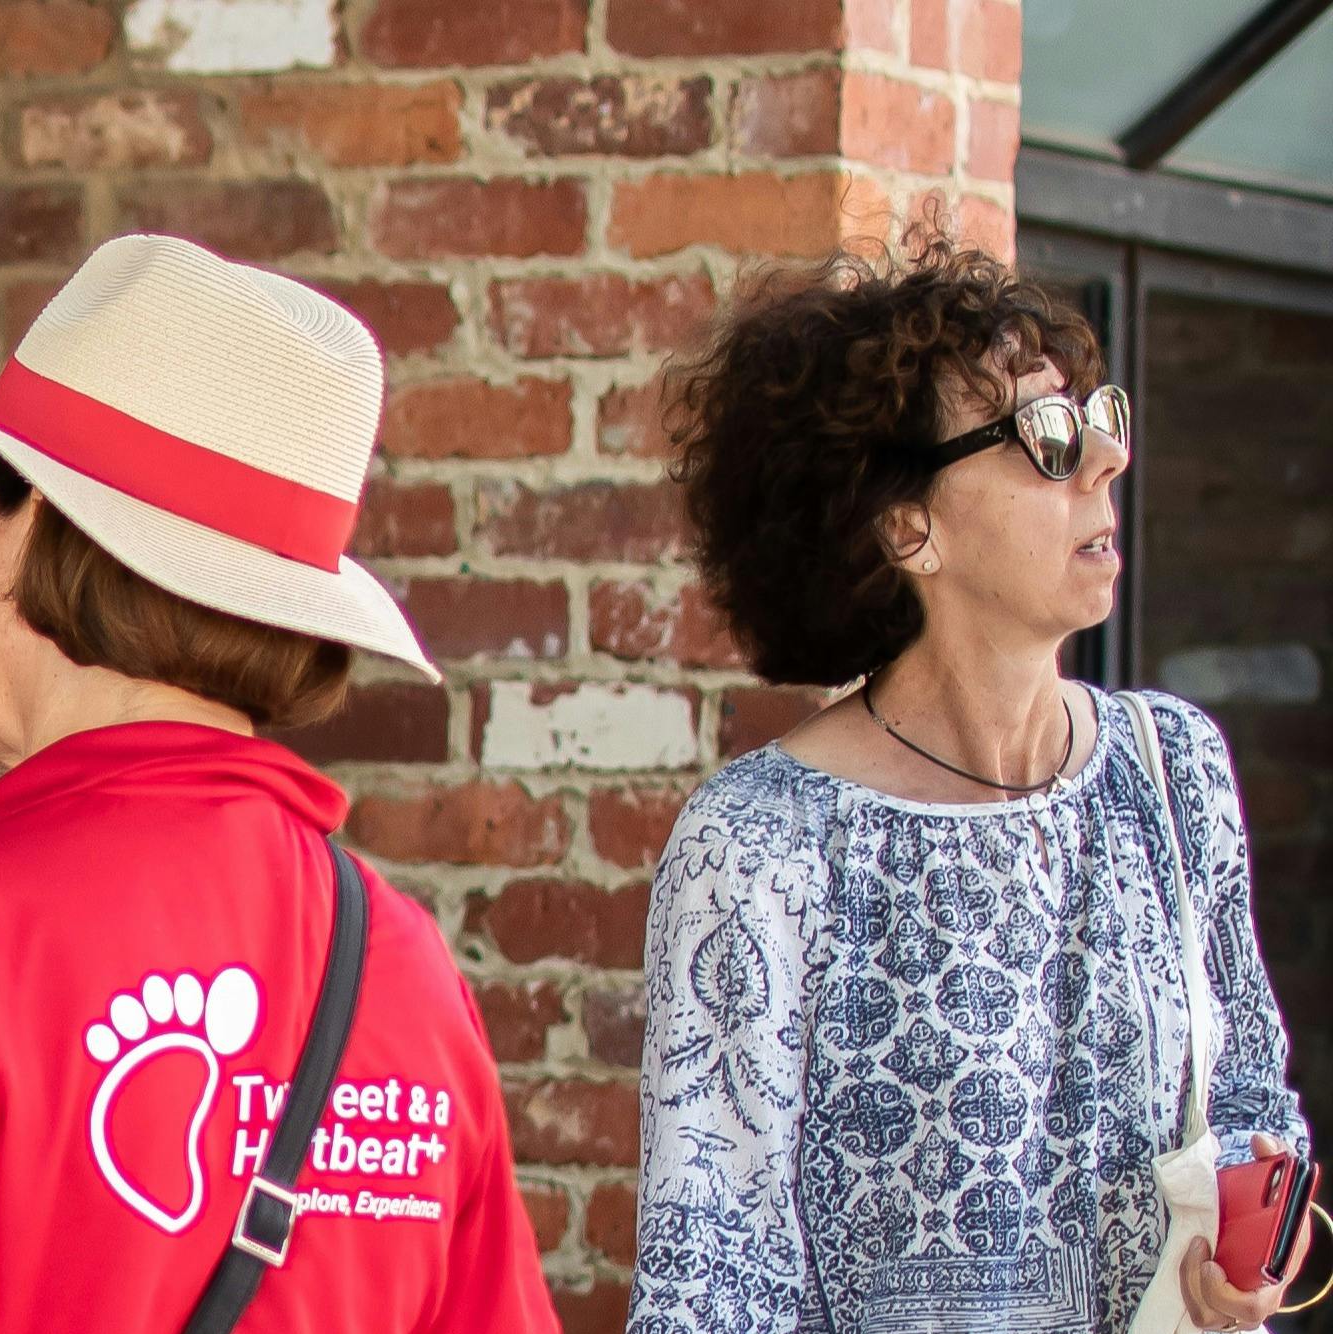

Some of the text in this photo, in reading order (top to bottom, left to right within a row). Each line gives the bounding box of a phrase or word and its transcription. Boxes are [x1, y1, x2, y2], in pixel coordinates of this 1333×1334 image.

[407, 1085, 430, 1123] &
[434, 1090, 449, 1126] a
[354, 1191, 440, 1220] Experience
